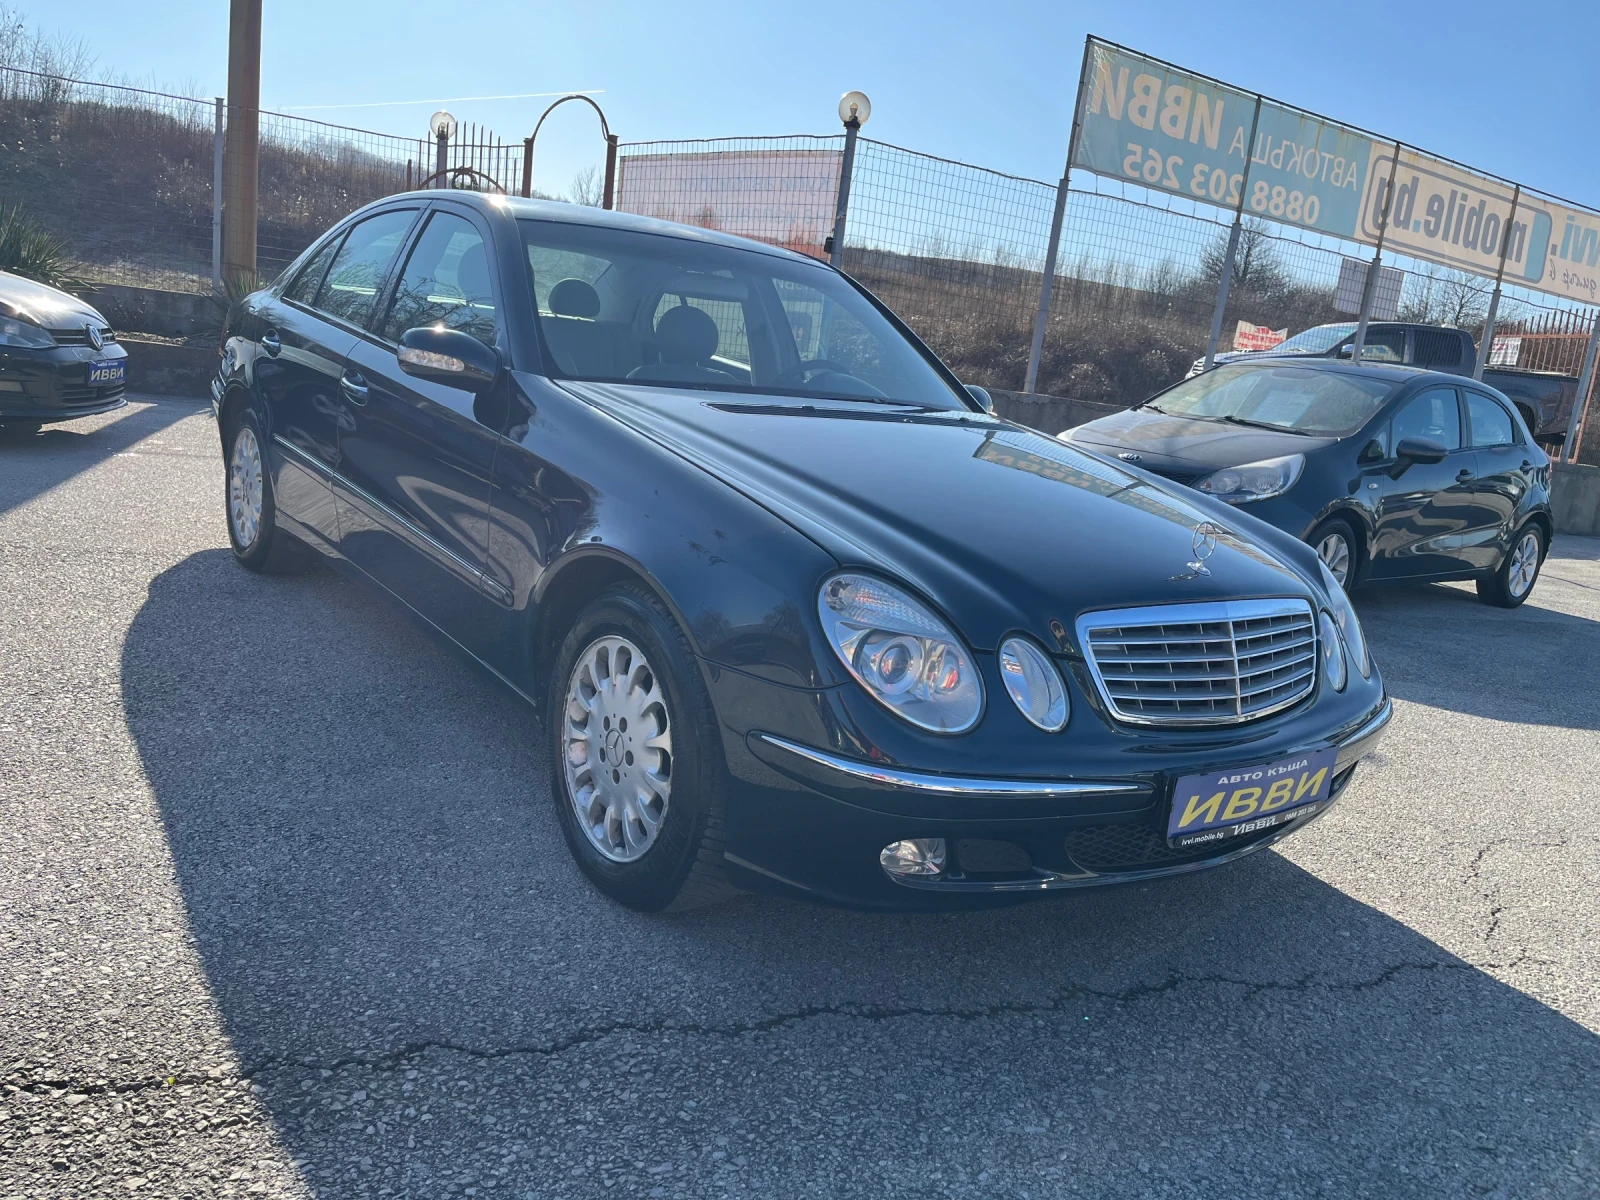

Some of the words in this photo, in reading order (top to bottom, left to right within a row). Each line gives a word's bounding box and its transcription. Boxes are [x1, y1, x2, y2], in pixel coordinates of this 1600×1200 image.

[91, 367, 124, 381] ИВВИ
[1217, 771, 1263, 785] АВТО
[1267, 759, 1308, 777] КЪЩА
[1177, 766, 1329, 828] ИВВИ
[1231, 817, 1279, 836] ИВВИ
